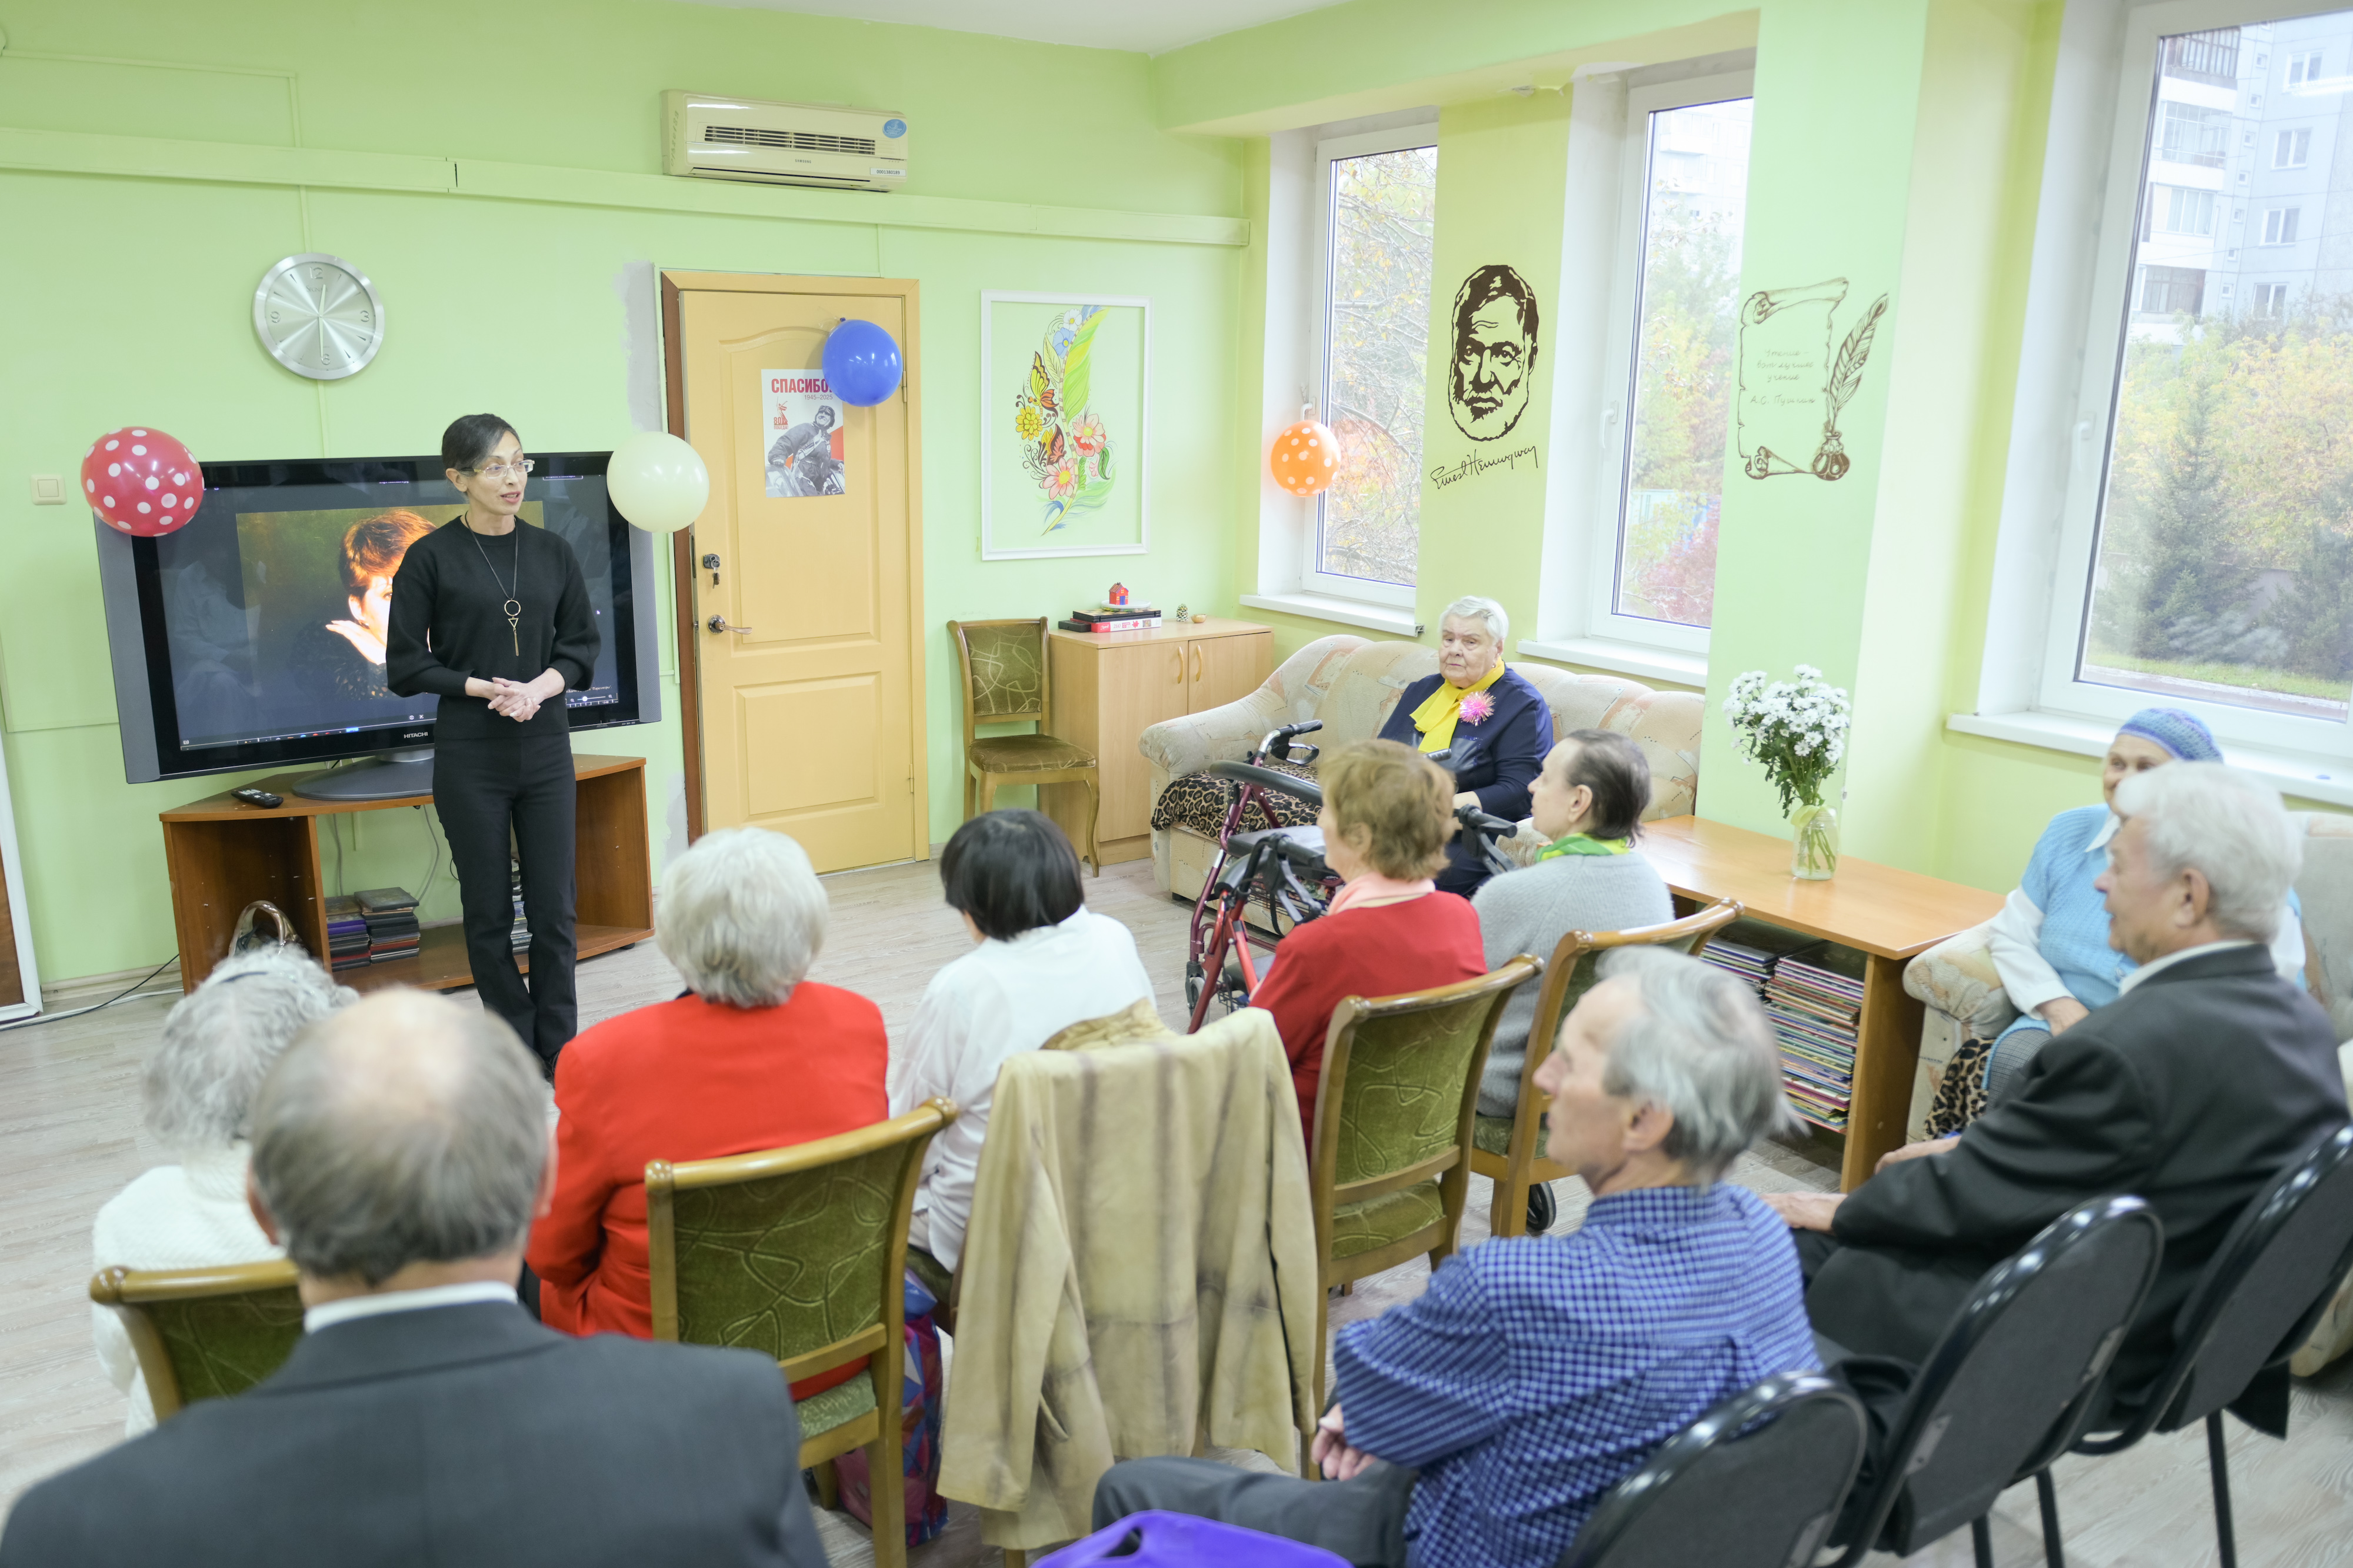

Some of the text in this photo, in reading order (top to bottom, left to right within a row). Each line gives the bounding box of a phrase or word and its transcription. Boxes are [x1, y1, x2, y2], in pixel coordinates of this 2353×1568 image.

[309, 267, 323, 279] 12
[270, 311, 281, 323] 9
[359, 310, 370, 323] 3
[1765, 348, 1801, 357] Чтение
[321, 353, 331, 366] 6
[1757, 359, 1815, 370] вот лучшее
[1767, 373, 1800, 383] учение
[771, 378, 832, 393] СПАСИБО
[1774, 393, 1817, 406] Пушкин
[774, 416, 782, 425] 80
